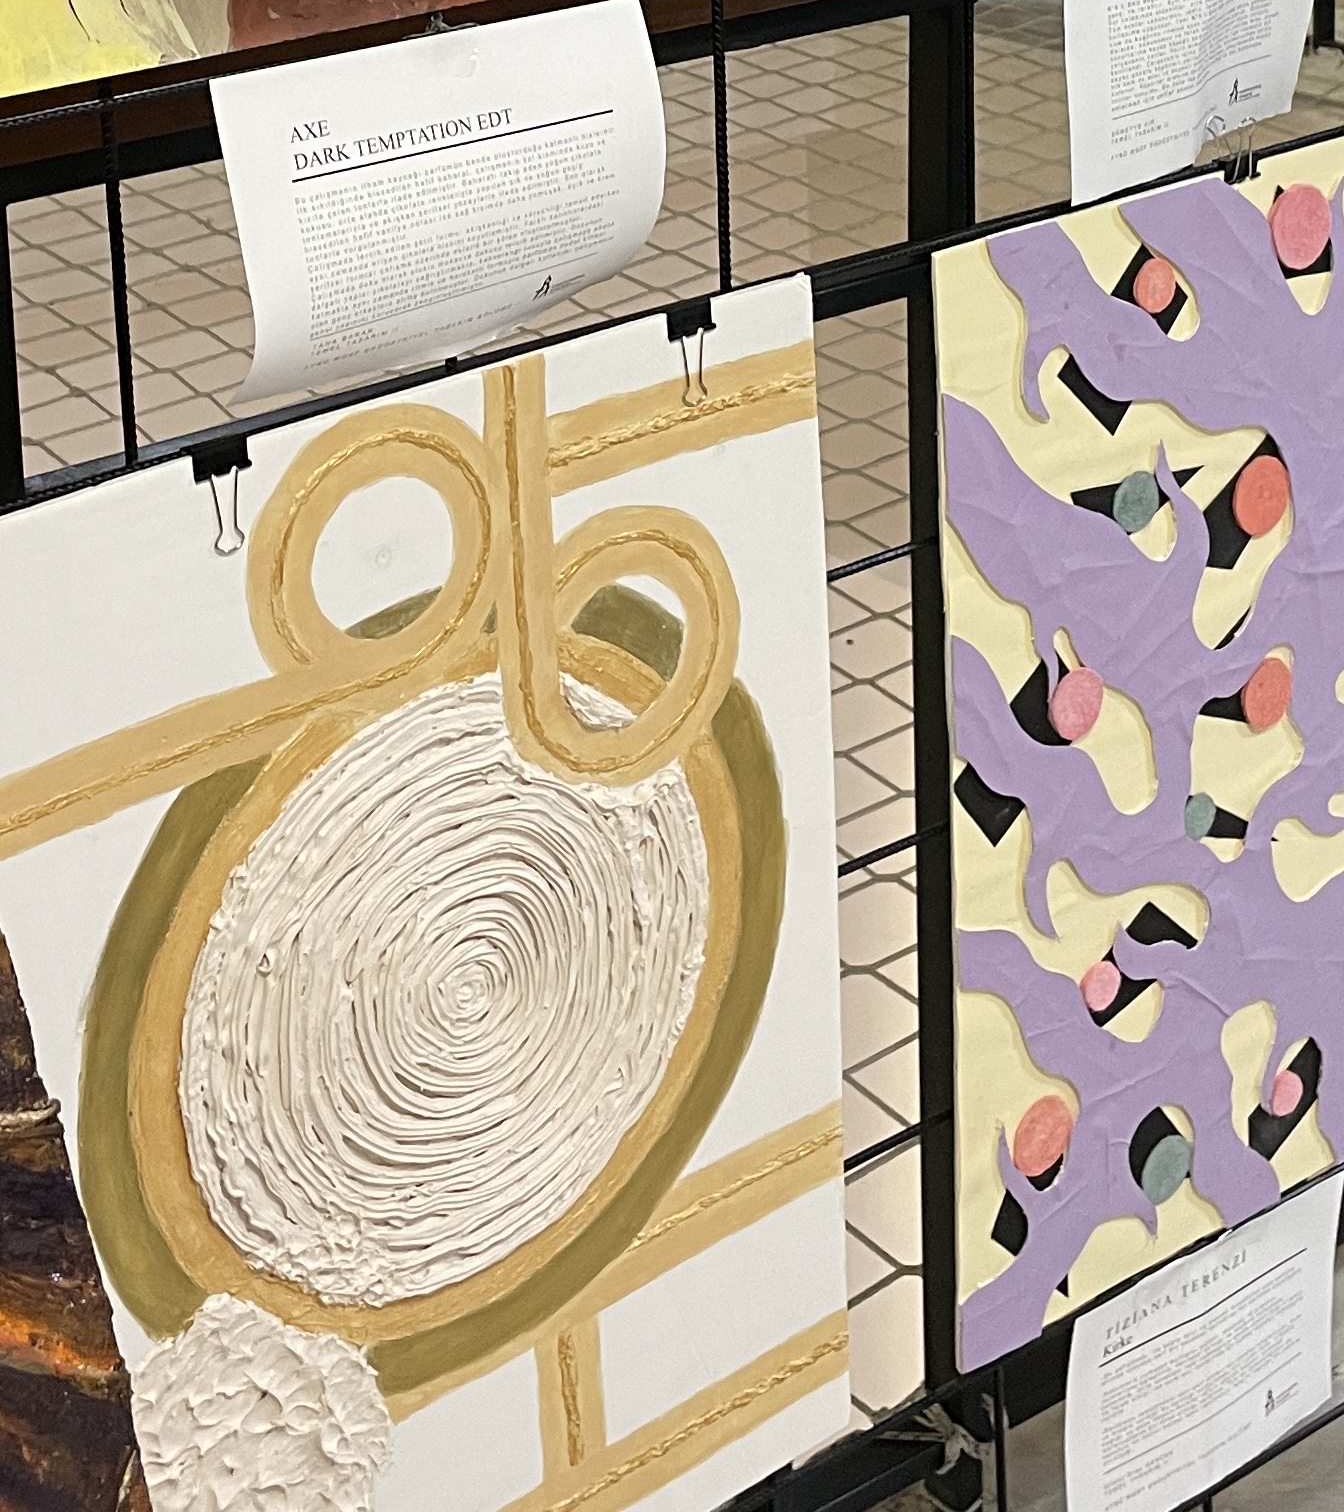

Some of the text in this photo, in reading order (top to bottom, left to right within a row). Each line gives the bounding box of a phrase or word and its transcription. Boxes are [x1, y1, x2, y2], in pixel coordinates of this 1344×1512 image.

[290, 119, 331, 144] AXE
[293, 107, 513, 171] DARK TEMPTATION EDT
[1181, 1249, 1247, 1298] TERENZI
